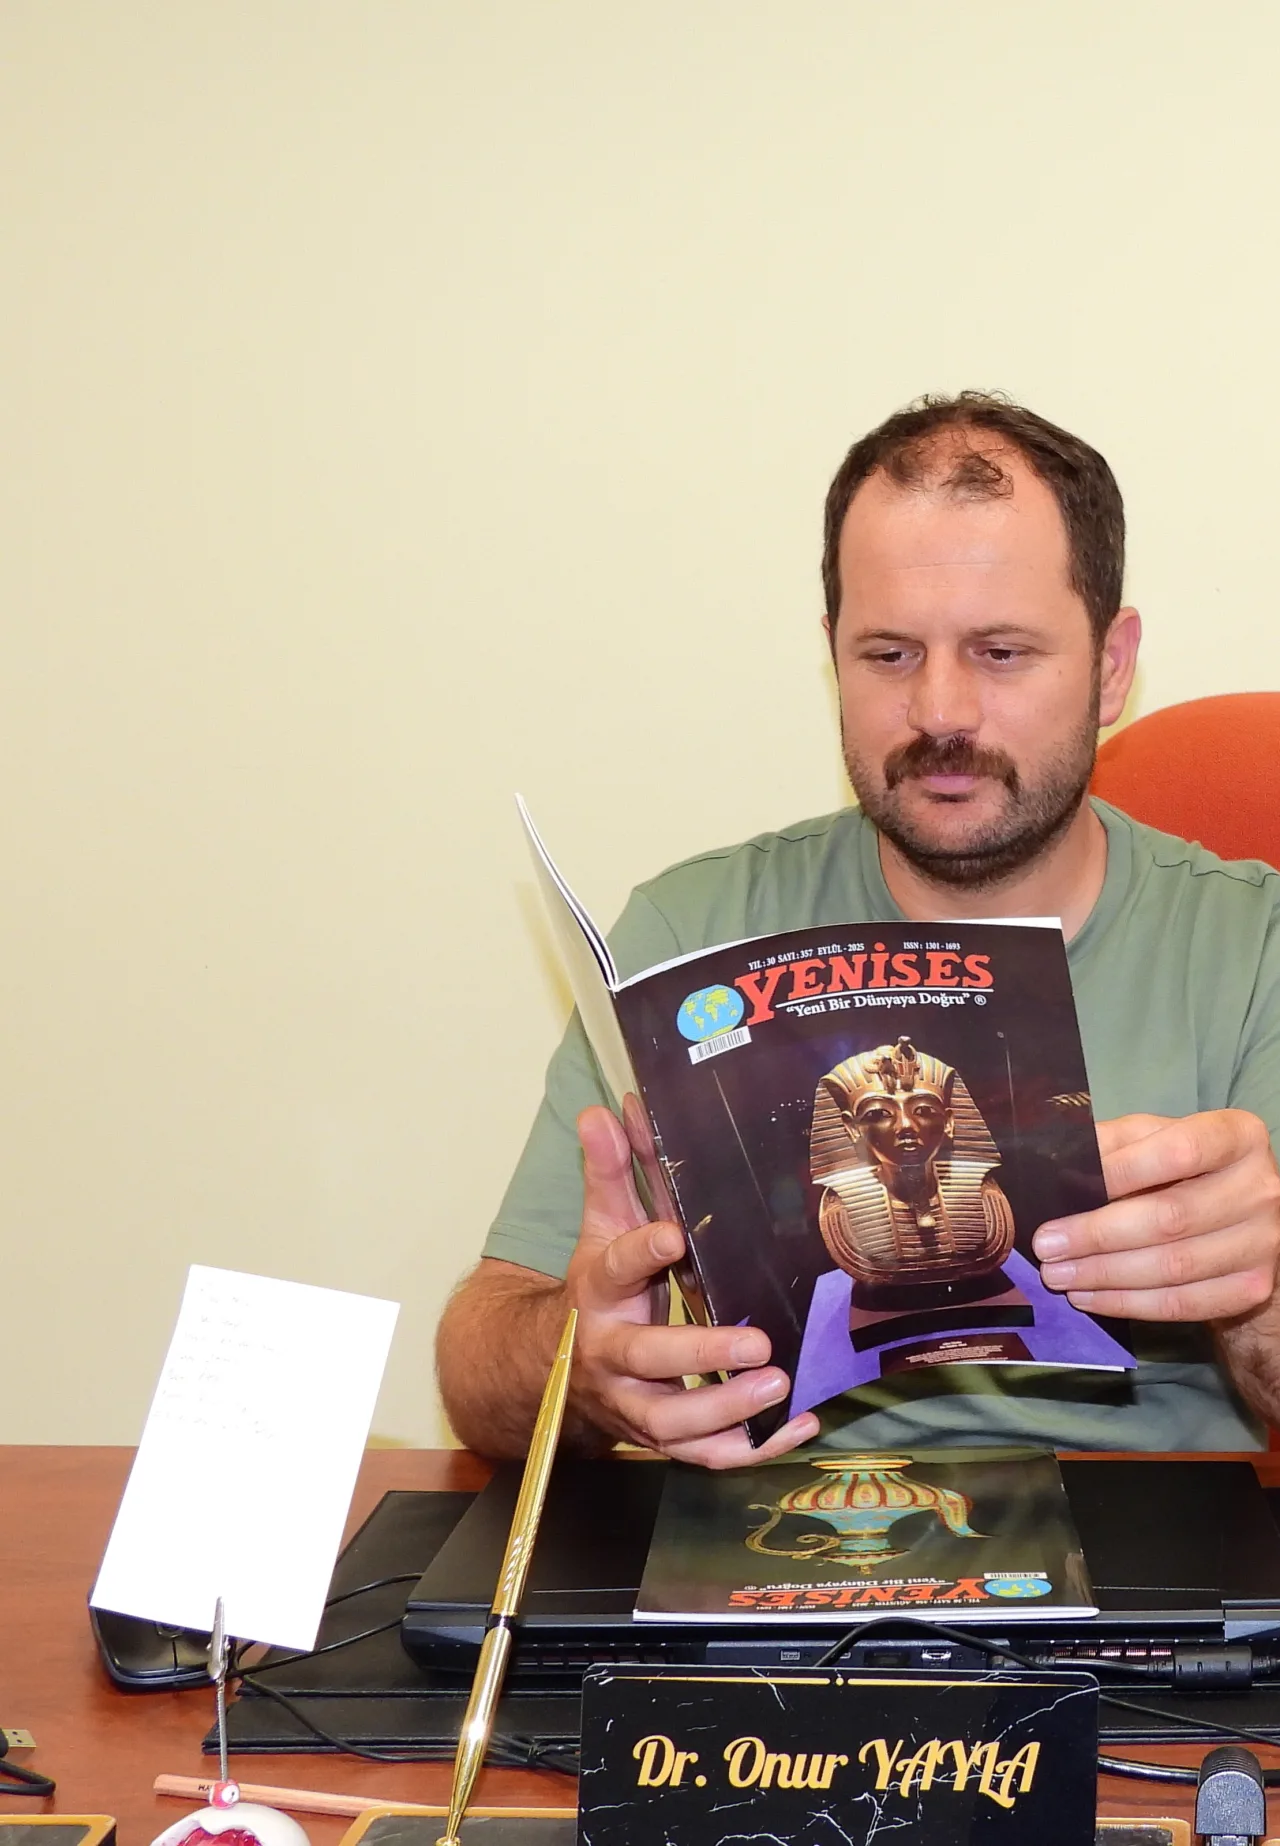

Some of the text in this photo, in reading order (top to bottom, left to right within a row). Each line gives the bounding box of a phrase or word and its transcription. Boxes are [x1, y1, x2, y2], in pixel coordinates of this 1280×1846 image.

[734, 942, 994, 1026] YENİSES
[827, 998, 851, 1011] Bir
[853, 993, 917, 1009] Dünyaya
[728, 1577, 990, 1609] YENİSES
[632, 1734, 1041, 1809] Dr. Onur YAYLA
